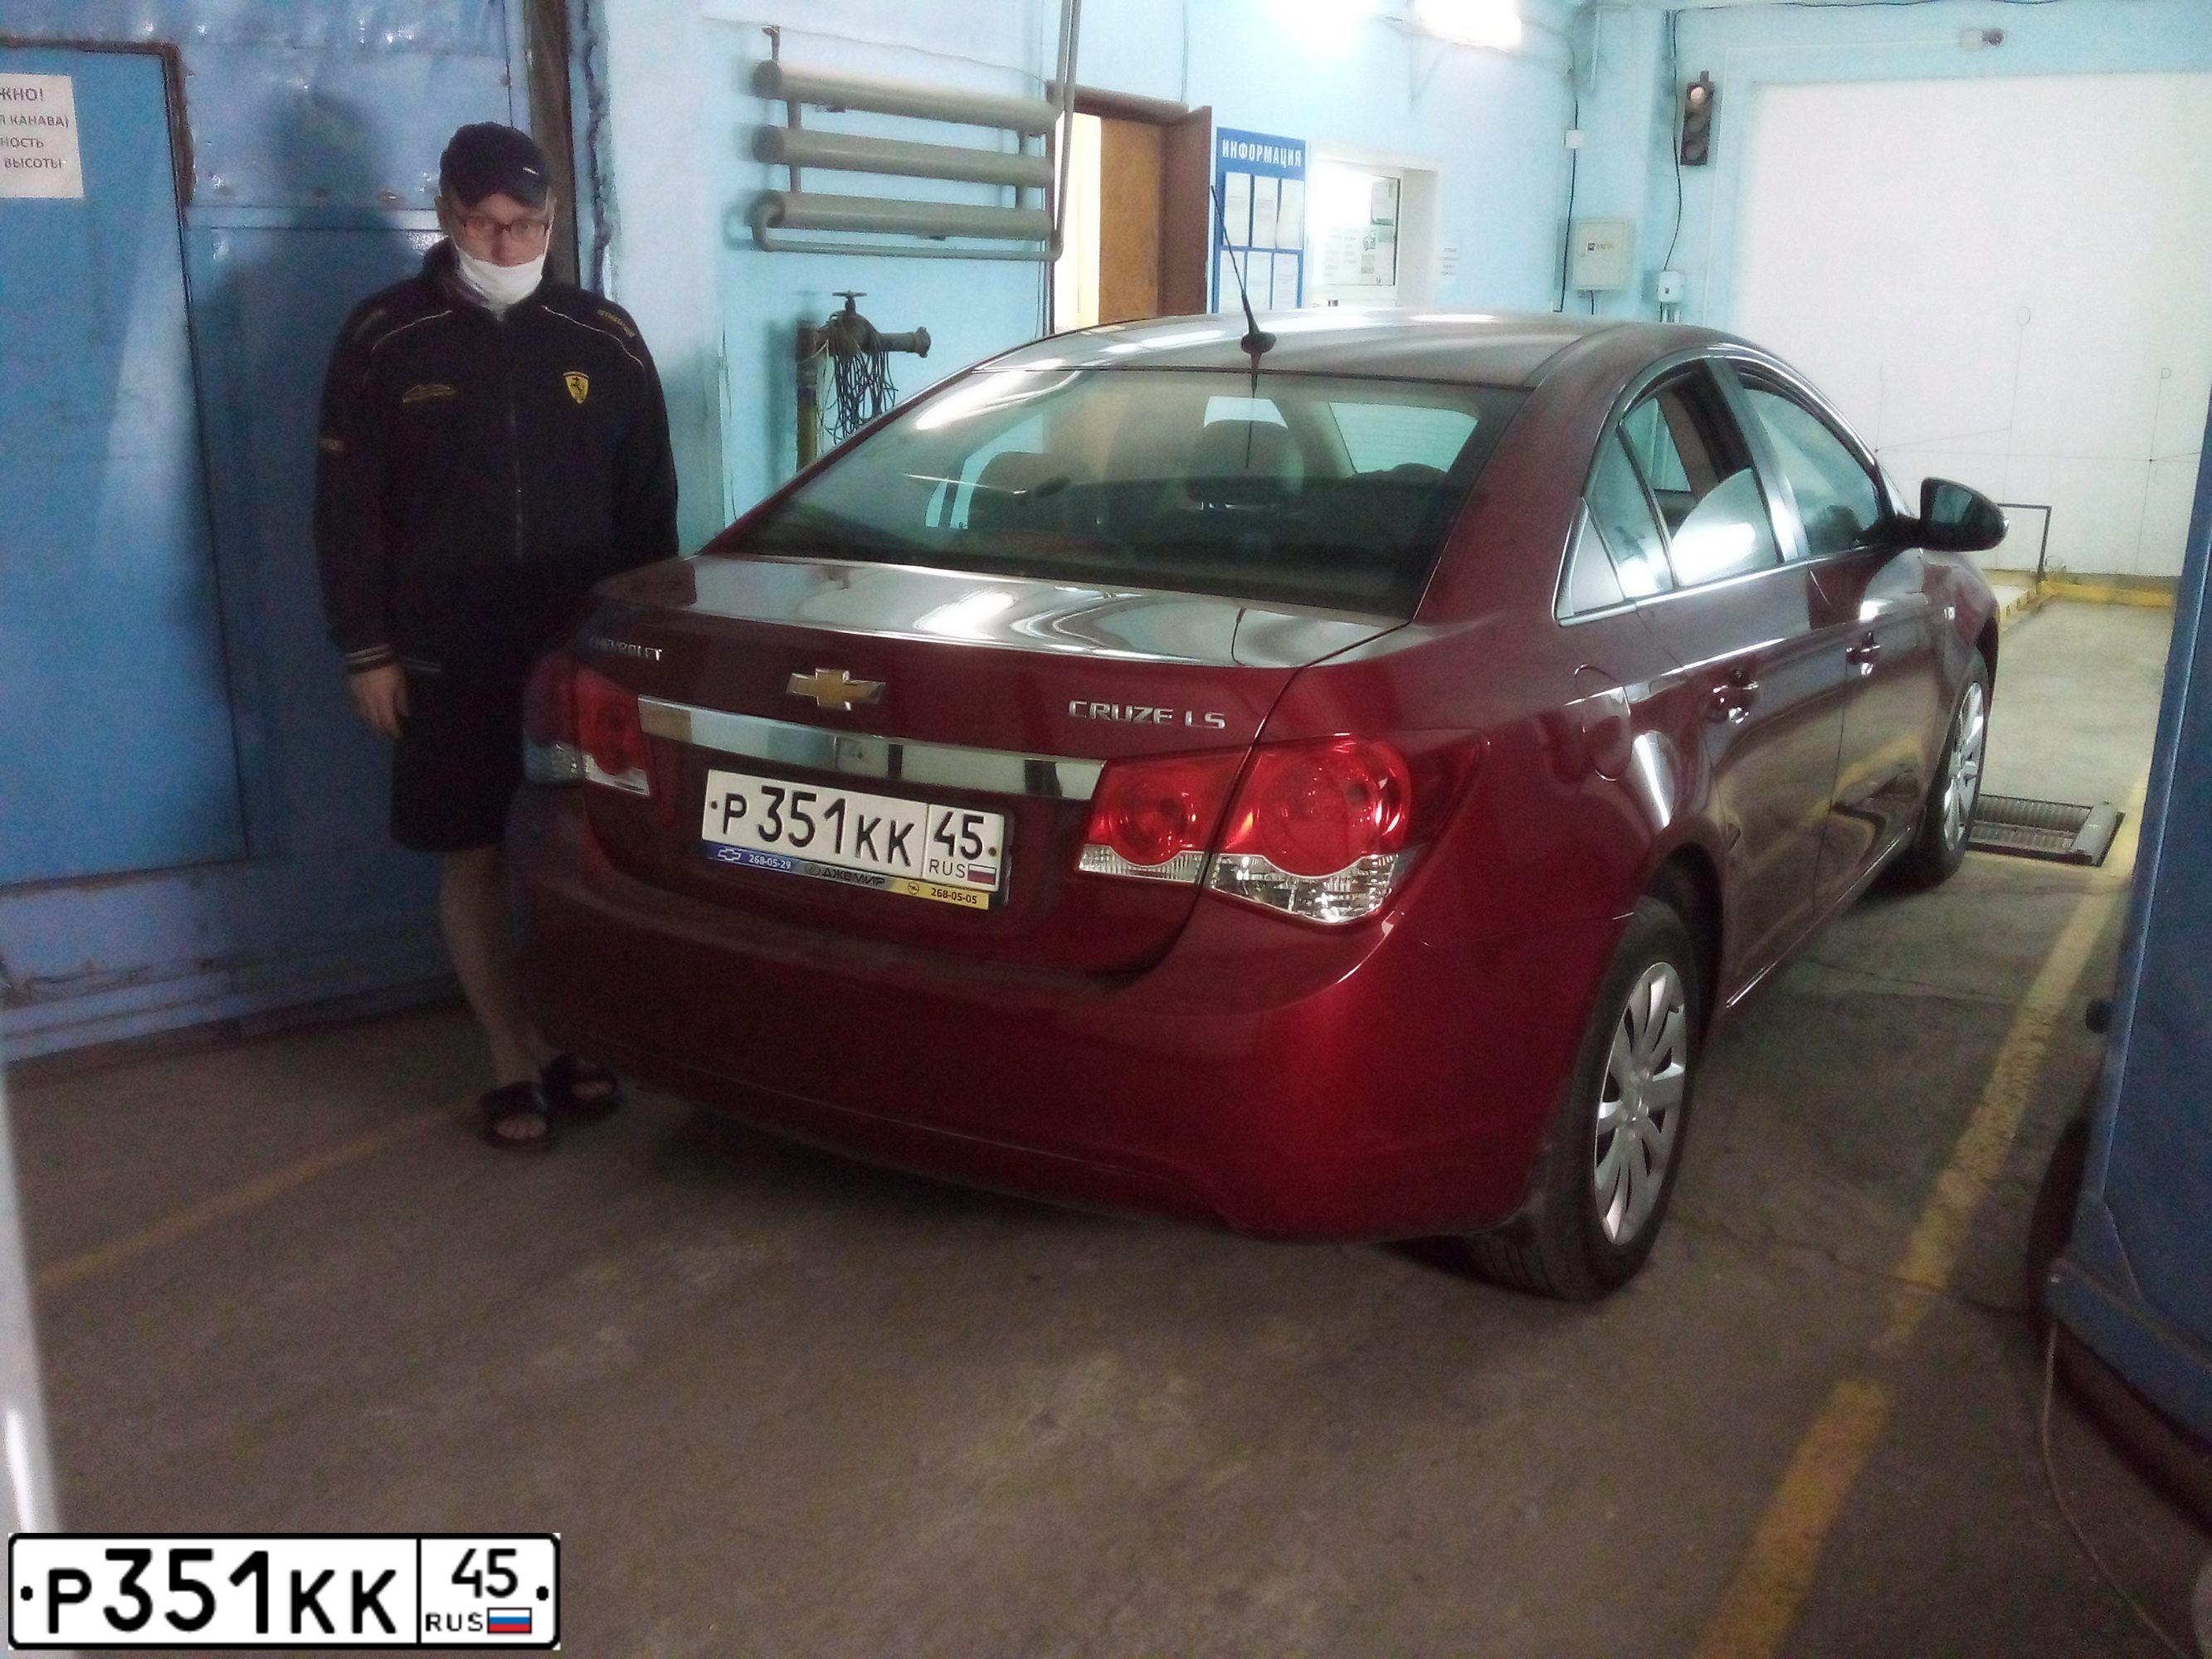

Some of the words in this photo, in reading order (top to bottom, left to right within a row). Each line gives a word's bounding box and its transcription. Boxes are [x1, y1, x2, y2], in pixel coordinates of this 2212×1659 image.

[11, 114, 69, 128] КАНАВА)
[1222, 139, 1302, 168] ИНФОРМАЦИЯ
[4, 158, 62, 168] ВЫСОТЫ
[1068, 700, 1174, 724] CRUZE
[1184, 709, 1226, 729] LS
[723, 786, 915, 868] Р351КК
[933, 811, 985, 861] 45
[748, 854, 792, 870] 268-05-29
[928, 859, 967, 878] RUS
[931, 887, 977, 905] 268-05-05
